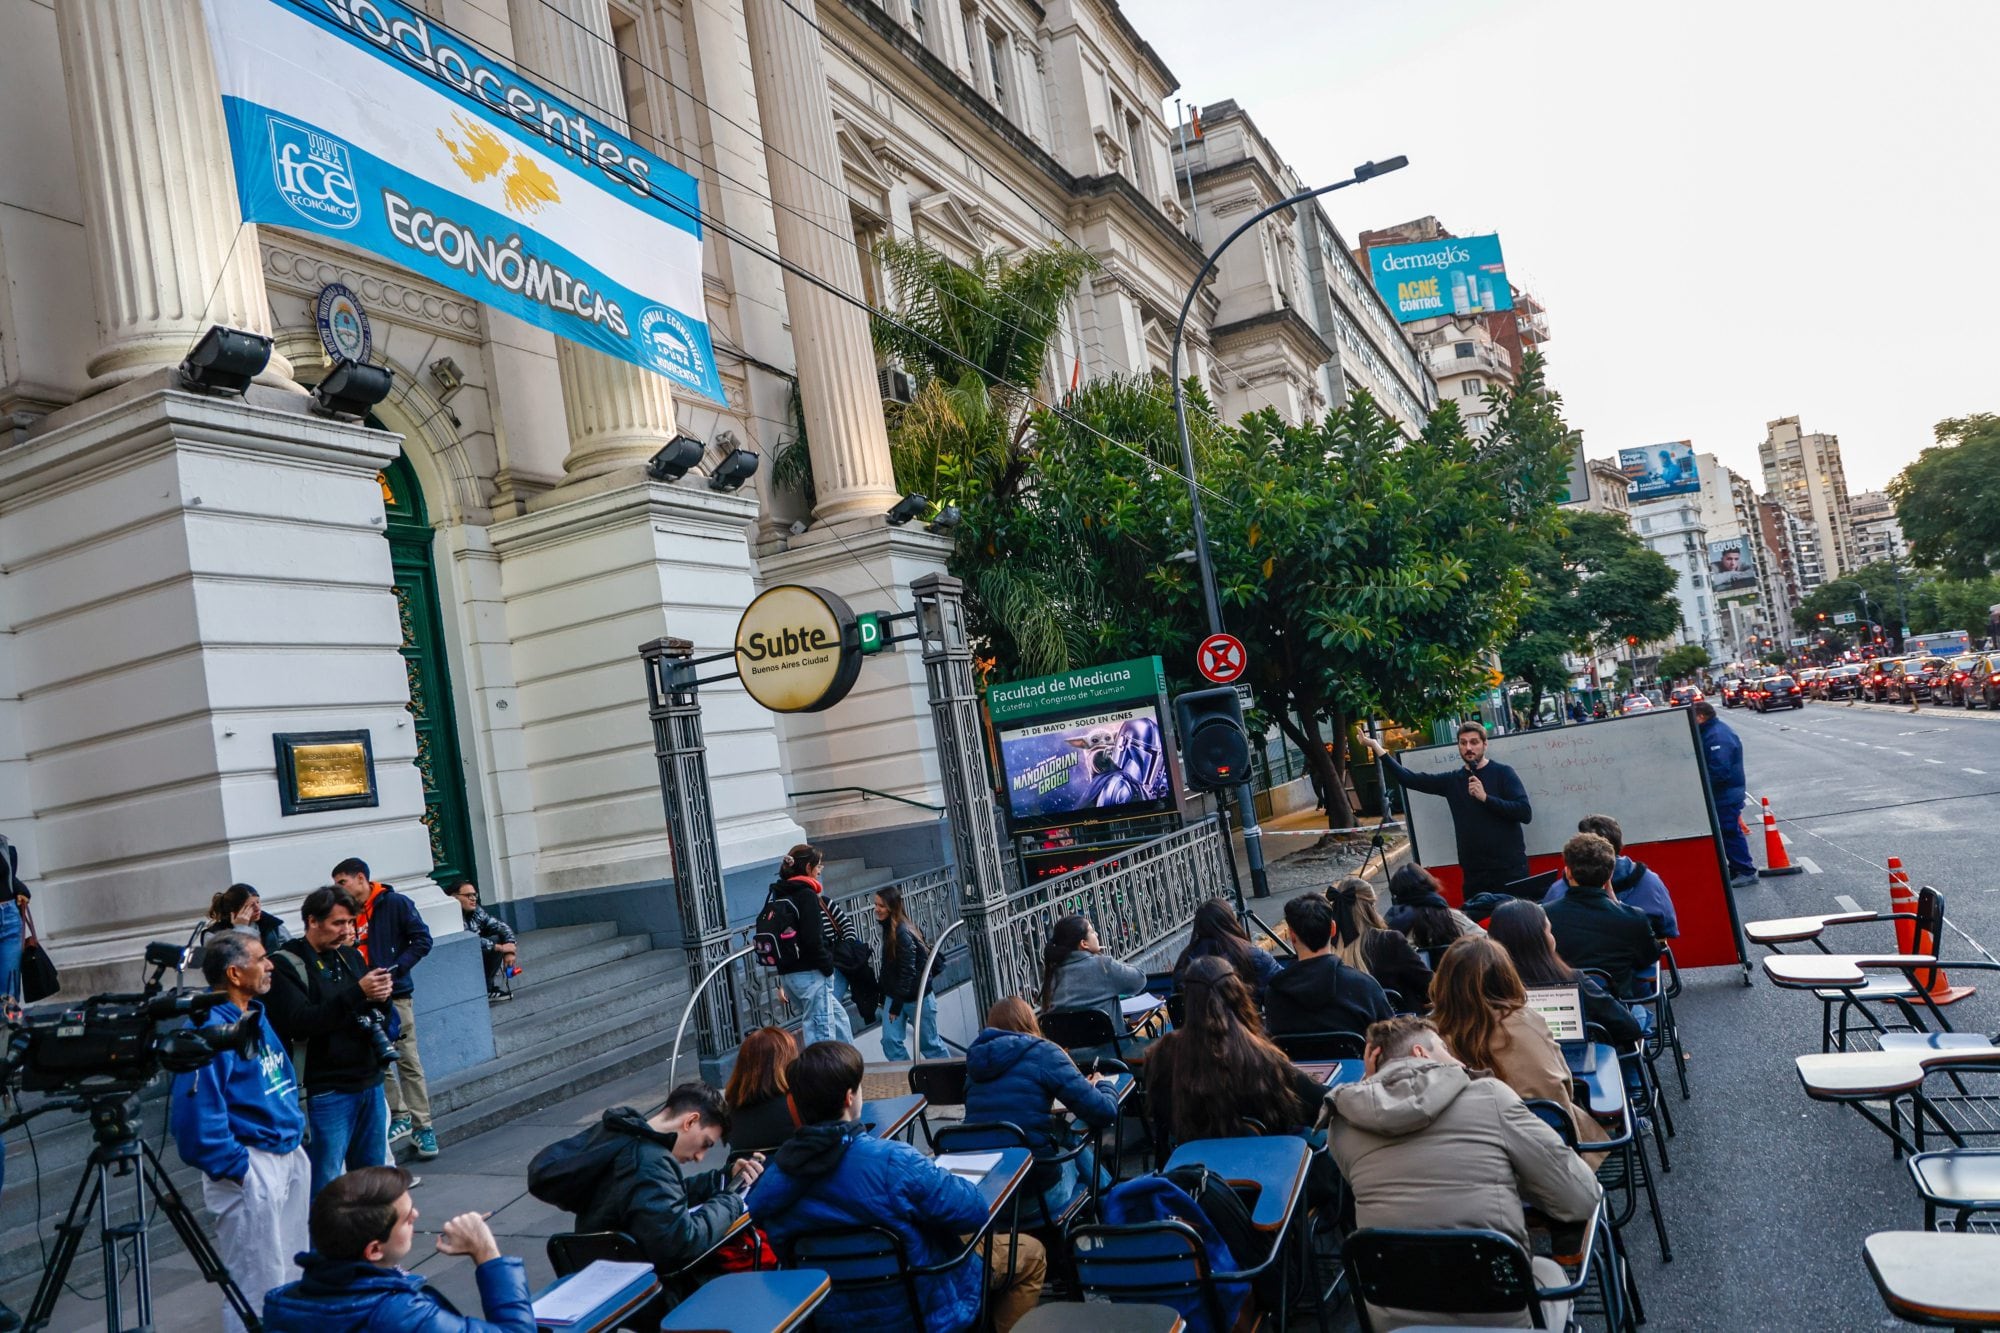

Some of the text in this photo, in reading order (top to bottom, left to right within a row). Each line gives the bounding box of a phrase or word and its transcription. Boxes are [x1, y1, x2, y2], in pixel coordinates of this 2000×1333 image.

[309, 147, 342, 167] UBA
[279, 143, 355, 208] fce
[291, 194, 353, 220] ECONÓMICAS
[383, 190, 630, 337] ECONÓMICAS
[1382, 245, 1470, 271] dermaglós
[1398, 275, 1440, 301] ACNÉ
[1400, 296, 1443, 312] CONTROL
[1712, 540, 1743, 552] EQUUS
[748, 627, 828, 661] Subte
[861, 623, 877, 643] D
[752, 655, 829, 675] Buenos Aires Ciudad
[992, 668, 1131, 702] Facultad de Medicina
[1001, 700, 1033, 713] Catedral
[1040, 693, 1077, 706] Congreso
[1078, 690, 1089, 699] de
[1021, 711, 1133, 737] 21 DE MAYO SOLO EN CINES
[1014, 752, 1078, 790] MANDALORIAN
[1038, 769, 1069, 795] GROGU
